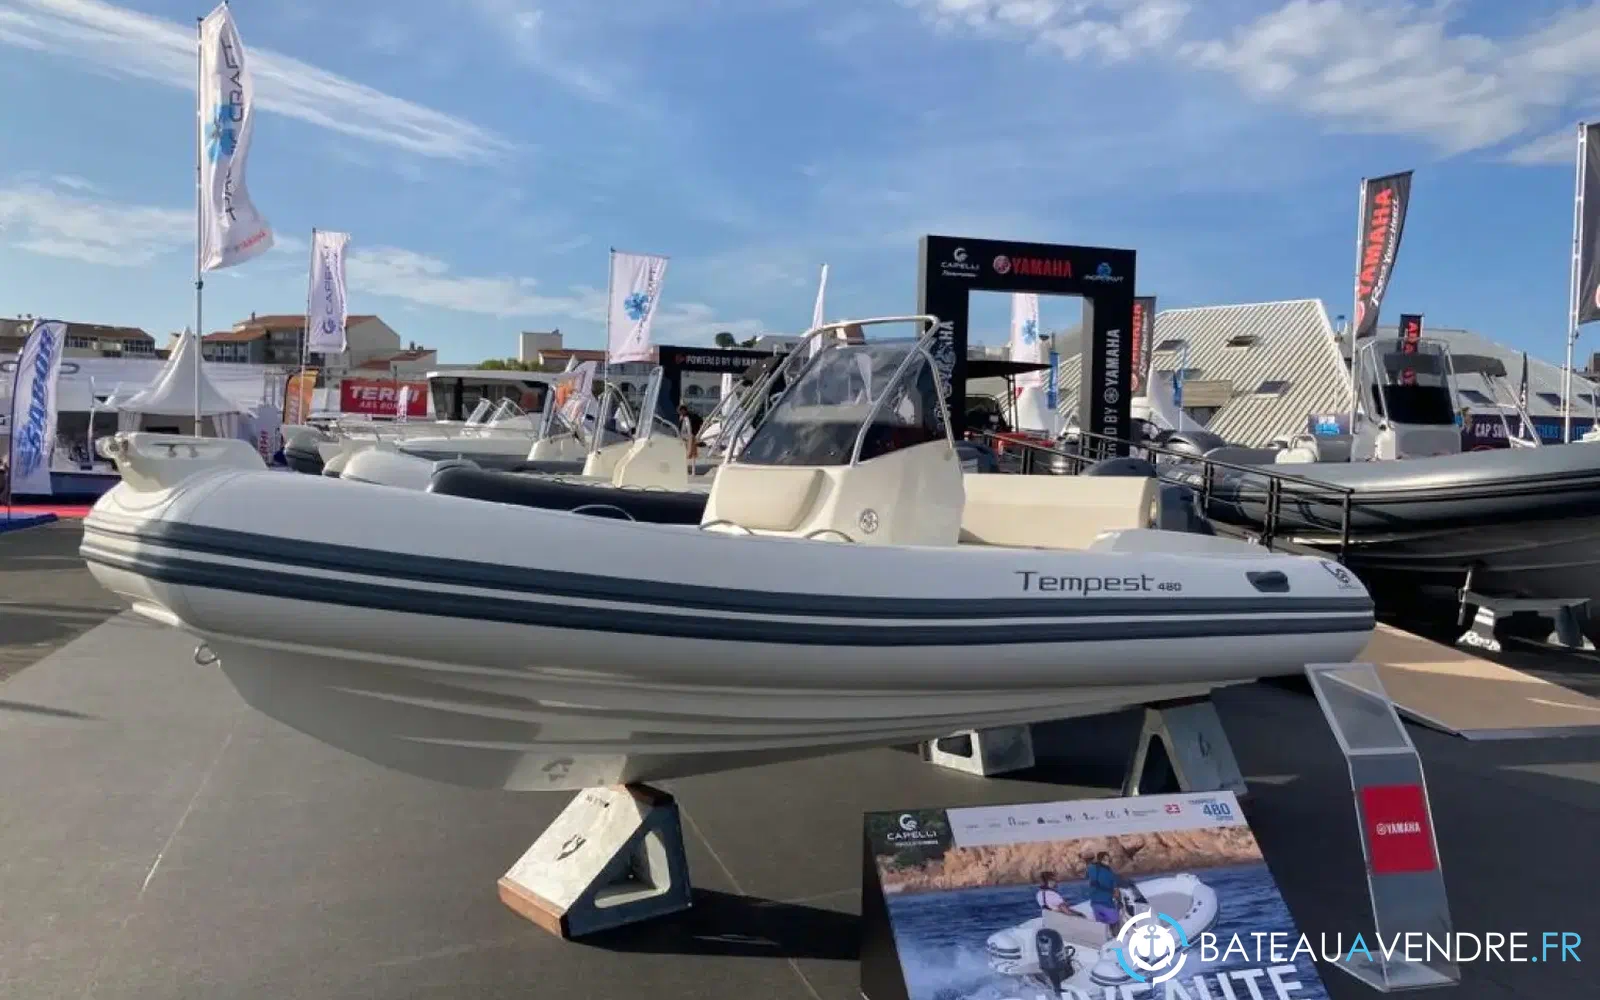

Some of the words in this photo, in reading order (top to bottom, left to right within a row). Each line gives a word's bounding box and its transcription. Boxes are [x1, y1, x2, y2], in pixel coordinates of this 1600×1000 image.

[1358, 187, 1393, 296] YAMAHA
[1012, 257, 1073, 279] YAMAHA
[686, 355, 720, 366] POWERED
[1105, 328, 1121, 387] YAMAHA
[1104, 407, 1118, 422] BY
[1474, 423, 1491, 437] CAP
[1013, 571, 1155, 596] Tempest
[1157, 582, 1182, 592] 480
[1165, 804, 1181, 814] 23
[1203, 803, 1231, 816] 480
[1387, 822, 1421, 834] YAMAHA
[887, 831, 937, 840] CAPELLI
